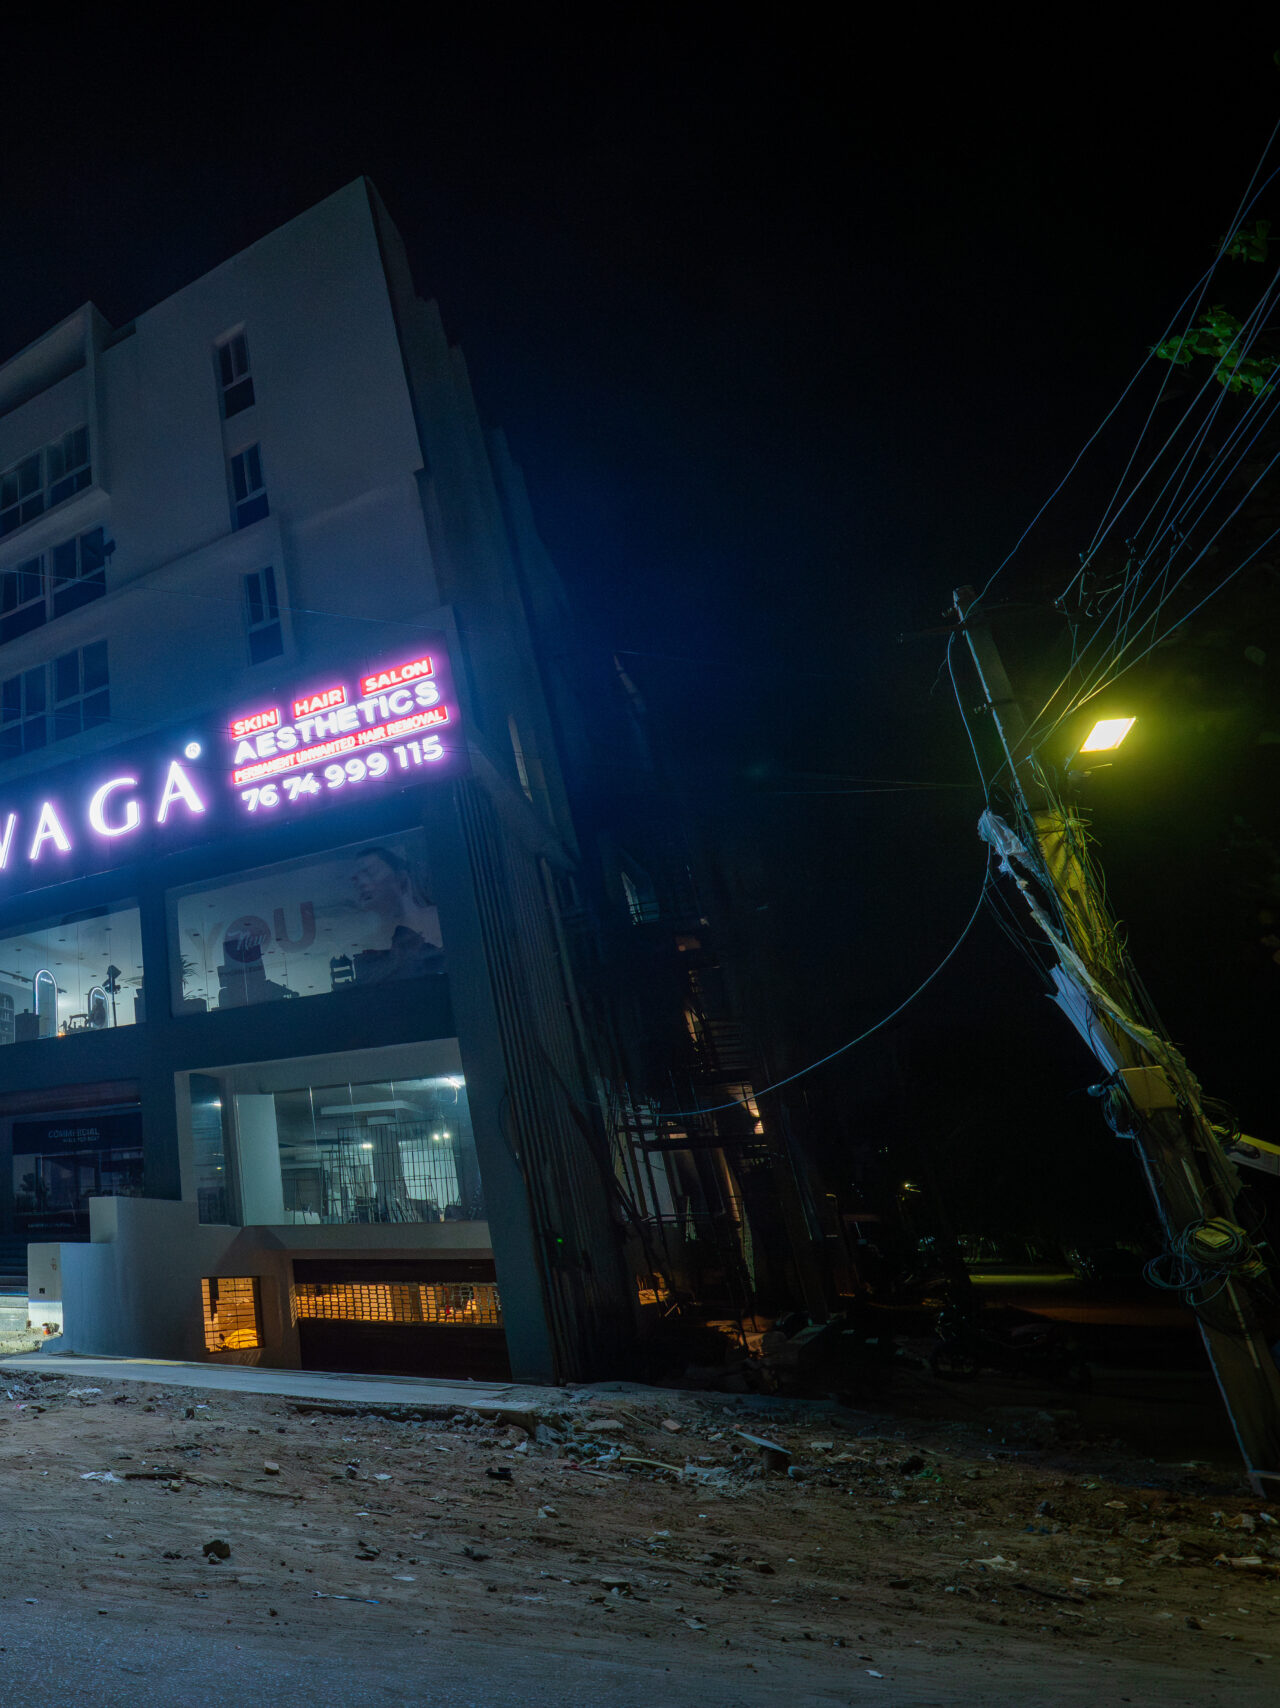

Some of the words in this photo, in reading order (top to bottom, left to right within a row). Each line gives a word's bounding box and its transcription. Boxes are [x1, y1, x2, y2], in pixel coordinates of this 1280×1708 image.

[365, 660, 428, 692] SALON
[233, 711, 276, 735] SKIN
[234, 681, 440, 764] AESTHETICS
[294, 689, 342, 716] HAIR
[234, 754, 296, 782] PERMANENT
[296, 736, 356, 763] UNWANTED
[358, 726, 386, 745] HAIR
[387, 711, 443, 735] REMOVAL
[241, 783, 279, 812] 76
[283, 772, 320, 800] 74
[324, 752, 389, 788] 999
[393, 735, 444, 769] 115
